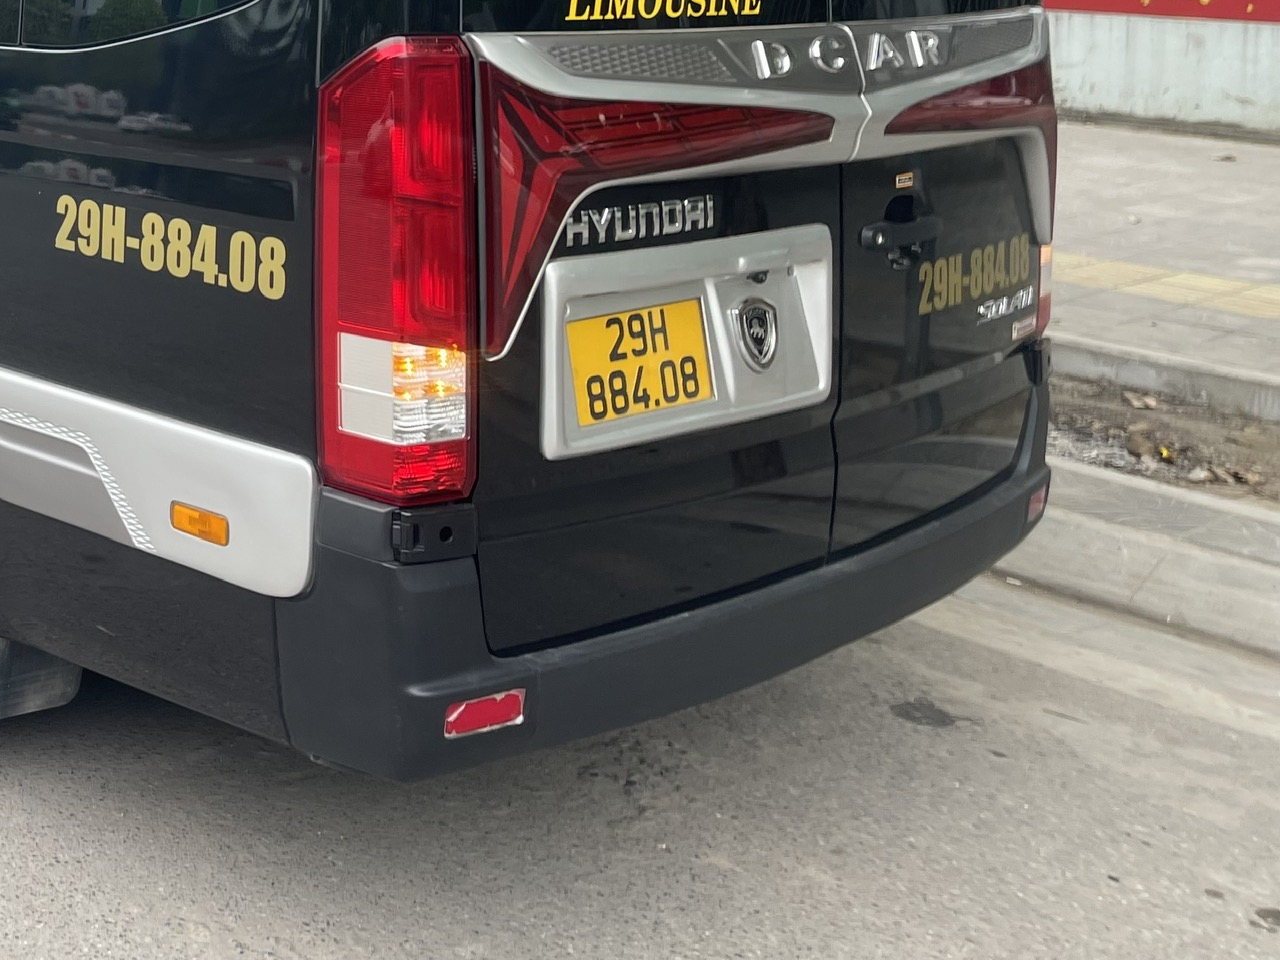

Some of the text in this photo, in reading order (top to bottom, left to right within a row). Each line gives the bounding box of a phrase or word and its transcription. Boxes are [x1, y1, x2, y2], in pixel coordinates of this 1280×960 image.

[54, 194, 287, 300] 29H-884.08
[566, 194, 714, 248] HYUNDAI
[918, 233, 1030, 316] 29H-884.08
[605, 308, 669, 362] 29H
[586, 356, 700, 420] 884.08
